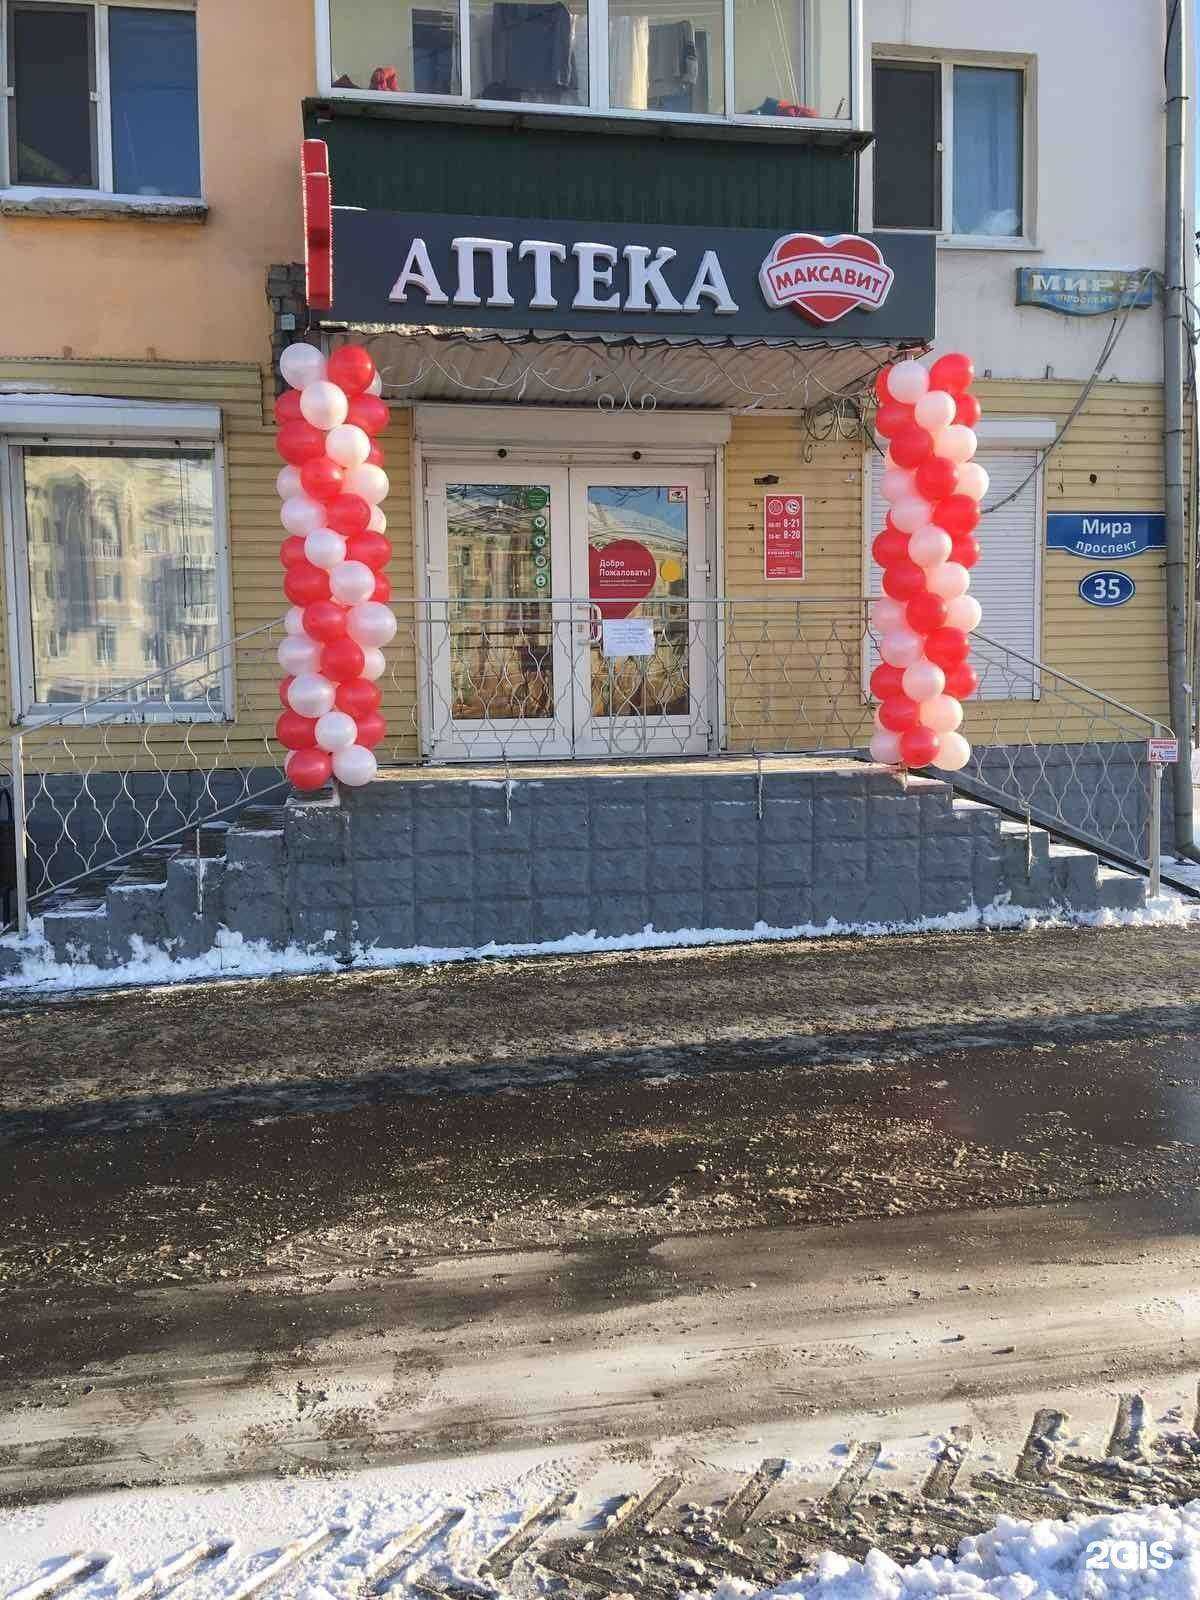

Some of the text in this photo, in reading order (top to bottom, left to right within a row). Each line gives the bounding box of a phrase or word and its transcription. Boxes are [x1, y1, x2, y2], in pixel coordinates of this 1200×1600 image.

[388, 237, 739, 314] АПТЕКА
[775, 265, 882, 293] МАКСАВИТ
[1082, 518, 1132, 538] Мира
[1076, 540, 1137, 554] проспект
[599, 559, 625, 569] Добро
[599, 568, 651, 577] Пожаловать!
[1093, 578, 1120, 599] 35
